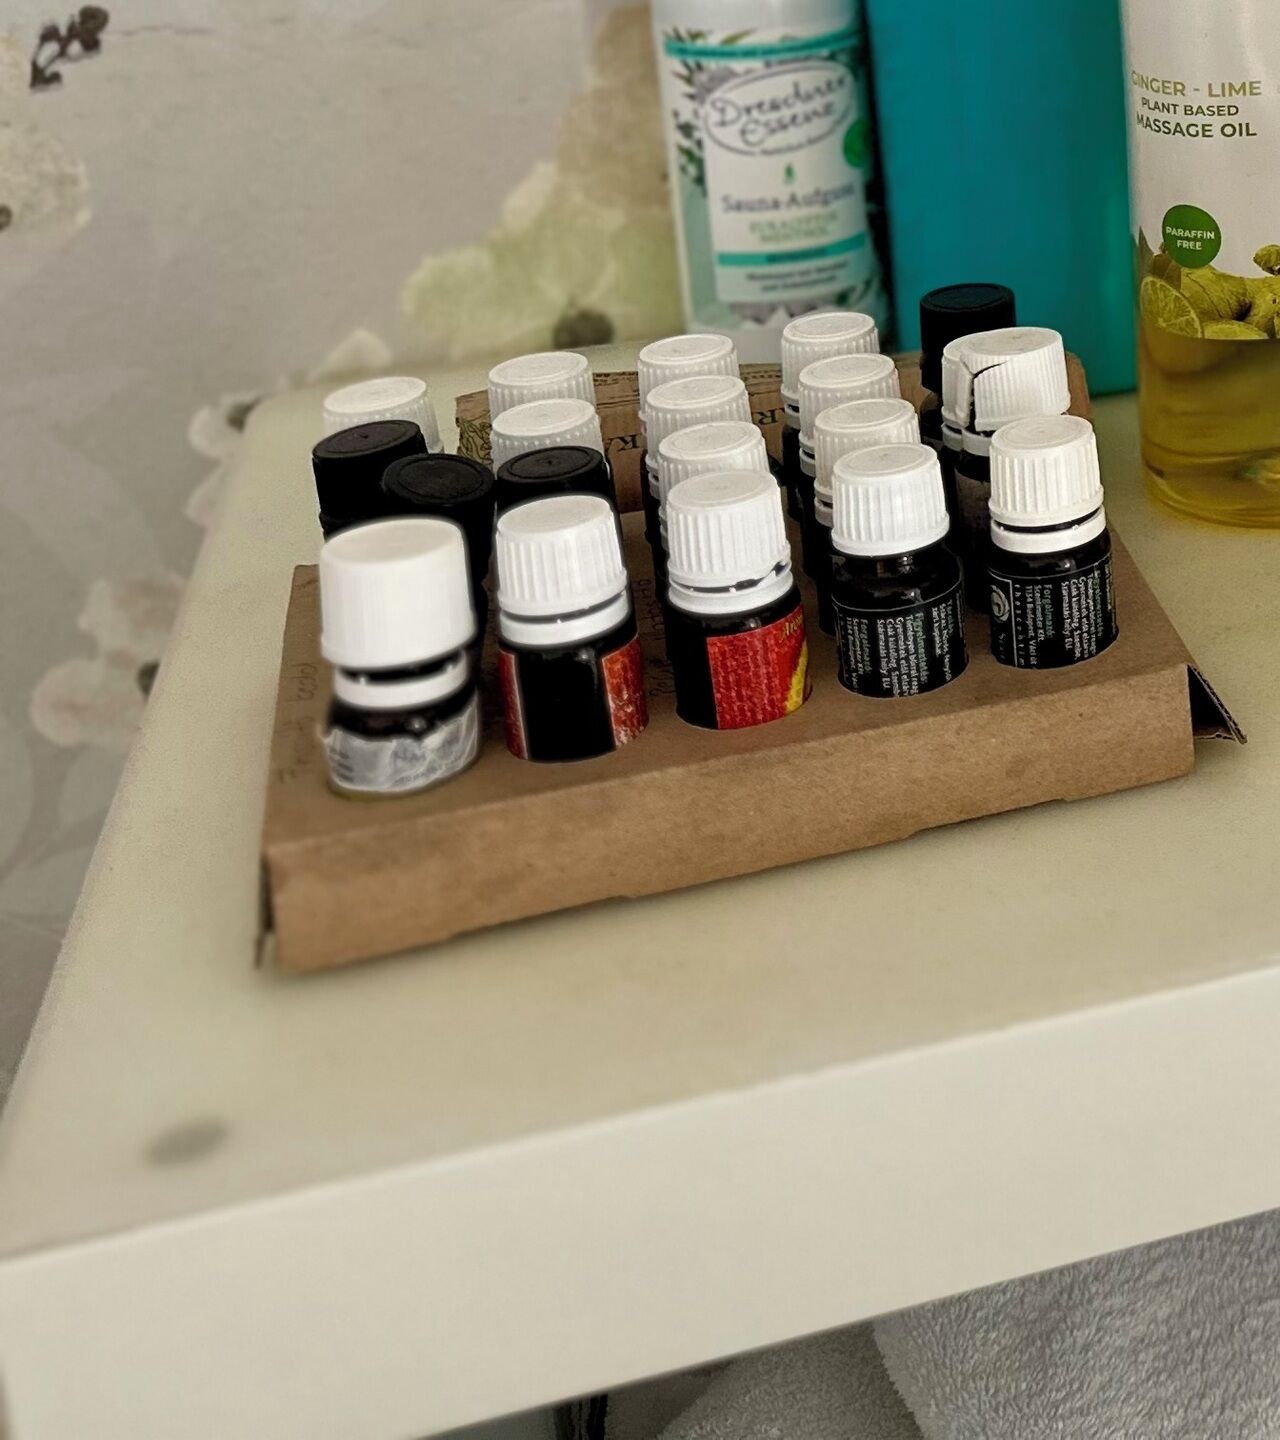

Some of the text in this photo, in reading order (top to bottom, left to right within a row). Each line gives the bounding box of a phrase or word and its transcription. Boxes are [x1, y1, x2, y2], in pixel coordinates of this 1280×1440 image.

[1130, 70, 1186, 96] GINGER
[1207, 80, 1262, 98] LIME
[1141, 97, 1239, 117] PLANT BASED
[1136, 110, 1257, 138] MASSAGE OIL
[1165, 226, 1215, 240] PARAFFIN
[1176, 240, 1202, 250] FREE
